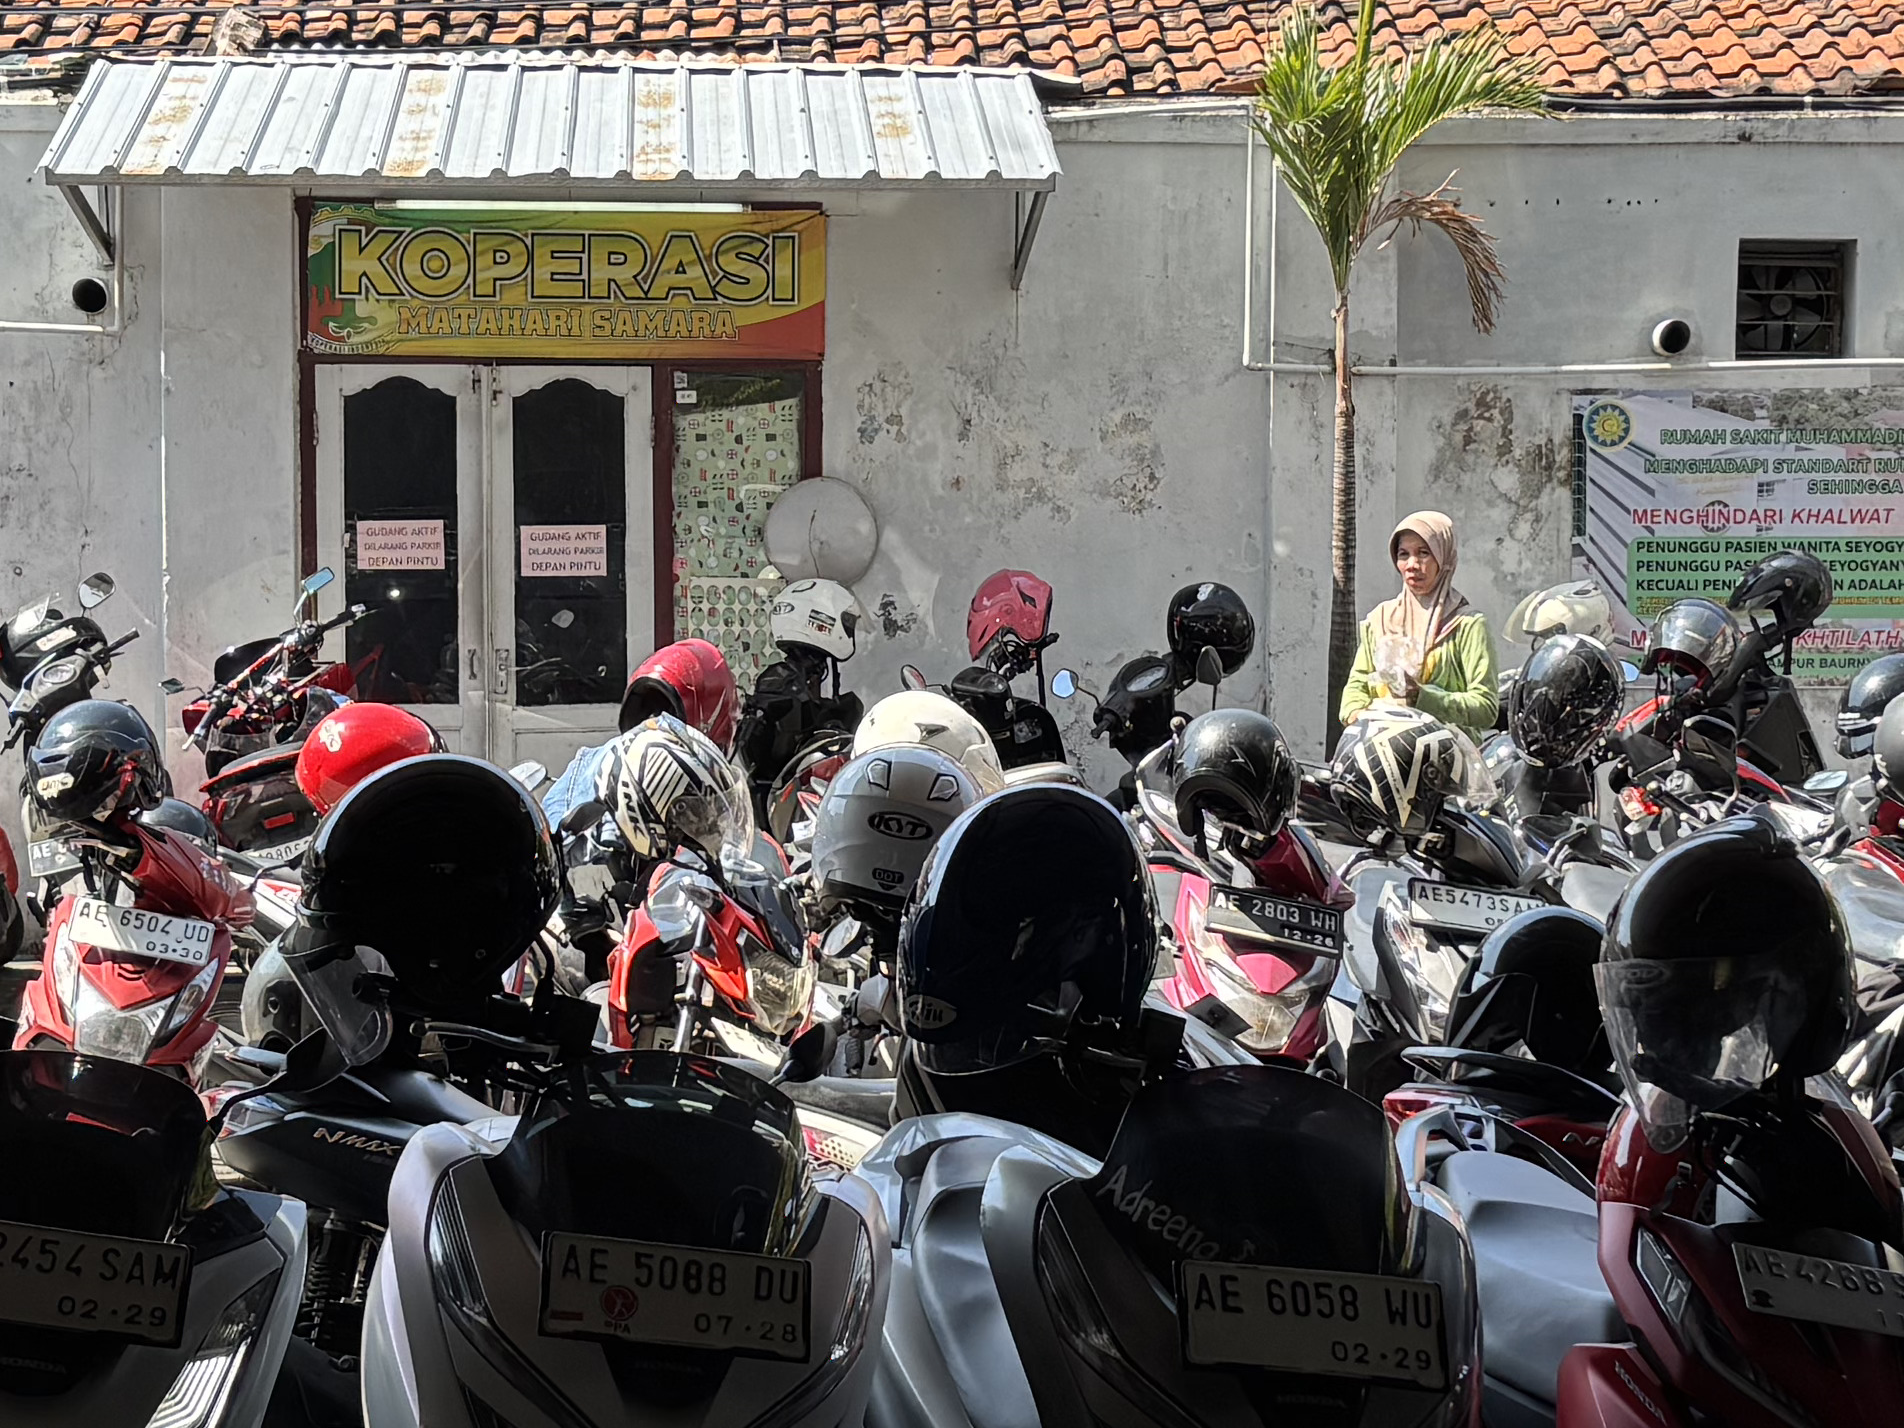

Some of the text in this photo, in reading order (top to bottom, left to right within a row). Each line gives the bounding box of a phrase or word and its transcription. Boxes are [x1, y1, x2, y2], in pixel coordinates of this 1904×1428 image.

[334, 224, 802, 306] KOPERASI
[397, 305, 739, 341] MATAHARI SAMARA
[1660, 429, 1726, 445] RUMAH
[1730, 429, 1783, 445] SAKIT
[1644, 458, 1769, 473] MENGHADAPI
[1772, 459, 1871, 473] STANDART
[1807, 479, 1903, 494] SEHINGGA
[1633, 508, 1895, 525] MENGHINDARI KHALWAT
[366, 527, 439, 537] GUDANG AKTIF
[530, 532, 602, 542] GUDANG AKTIF
[364, 542, 407, 551] DILARANG
[528, 547, 571, 556] DILARANG
[1636, 541, 1720, 553] PENUNGGU
[1724, 541, 1778, 553] PASIEN
[1781, 540, 1841, 553] WANITA
[368, 556, 438, 567] DEPAN PINTU
[531, 561, 601, 572] DEPAN PINTU
[1636, 560, 1720, 572] PENUNGGU
[1636, 579, 1698, 591] KECUALI
[874, 813, 927, 837] KYT
[32, 843, 52, 861] AE
[876, 870, 902, 883] DOT
[1418, 885, 1497, 911] AE 5473
[1214, 890, 1337, 933] AE 2803 WH
[79, 901, 211, 944] AE 6504 UD
[99, 1247, 182, 1290] SAM
[562, 1244, 610, 1284] AE
[754, 1265, 800, 1304] DU
[1746, 1248, 1886, 1295] AE 4268
[1194, 1273, 1433, 1329] AE 6058 WU
[1614, 1359, 1668, 1428] HONDA
